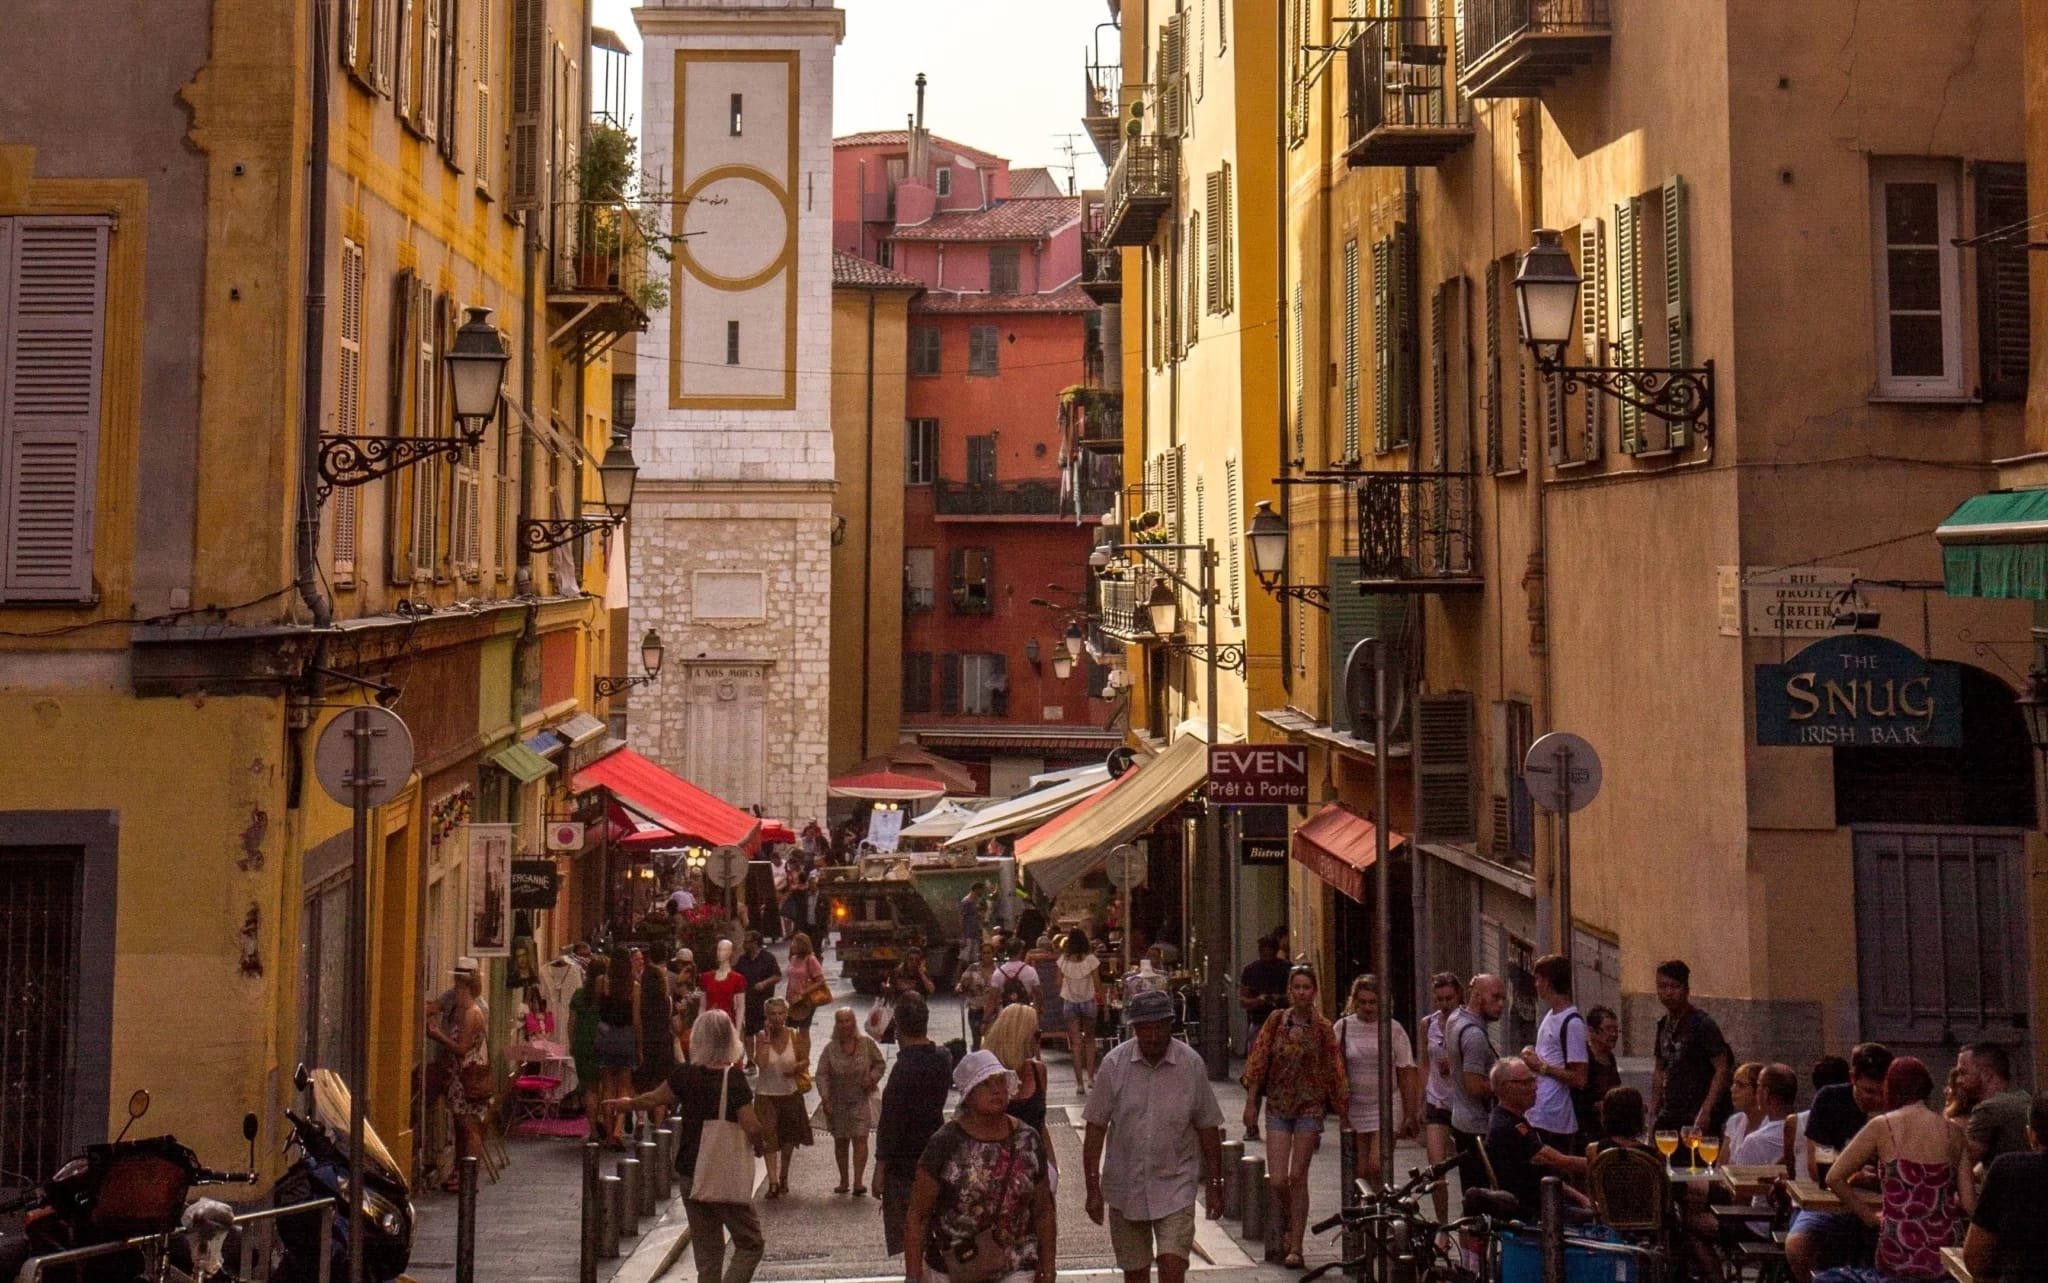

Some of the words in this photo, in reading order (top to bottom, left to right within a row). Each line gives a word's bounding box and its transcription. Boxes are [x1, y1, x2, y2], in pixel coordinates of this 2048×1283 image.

[1839, 654, 1879, 669] THE
[1786, 672, 1936, 729] SNUG
[1801, 725, 1856, 744] IRISH
[1871, 726, 1920, 744] BAR
[1211, 751, 1305, 774] EVEN
[1210, 781, 1240, 796] Prêt
[1244, 782, 1255, 796] à
[1260, 781, 1306, 796] Porter
[1250, 847, 1285, 857] Bistrot
